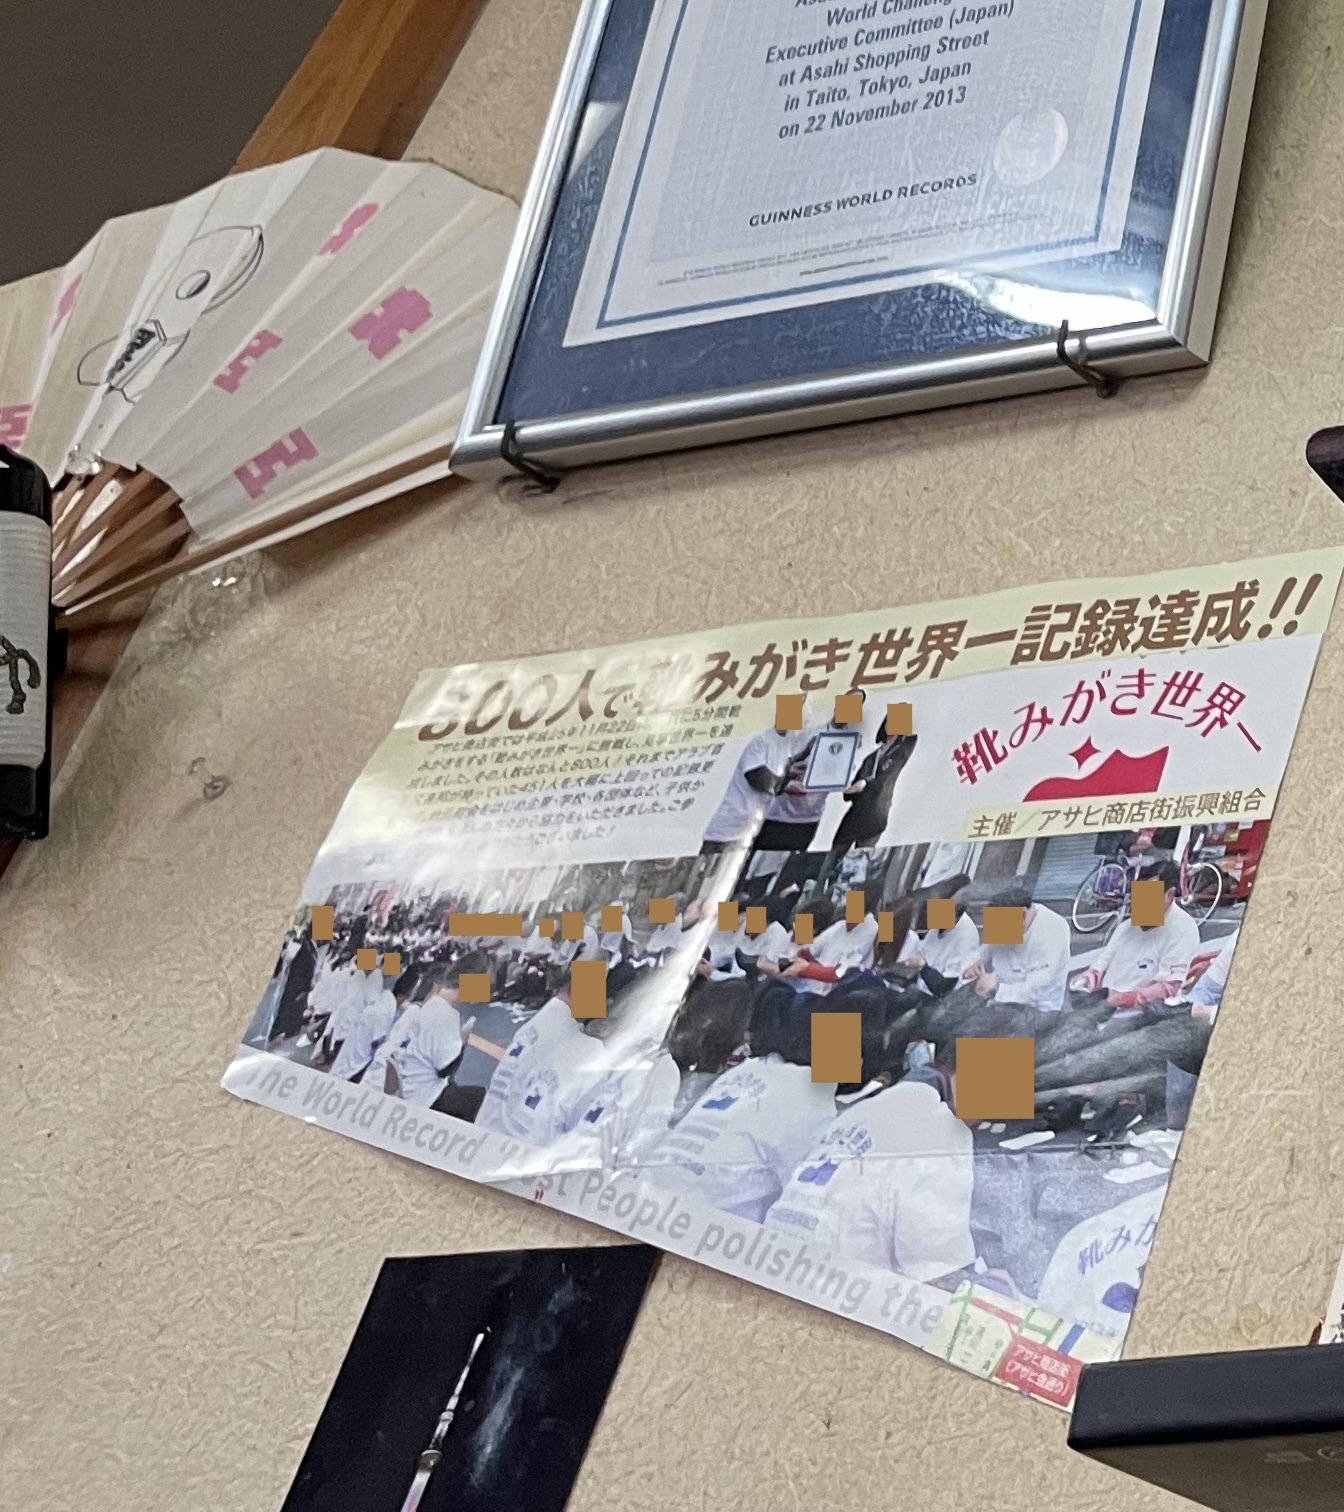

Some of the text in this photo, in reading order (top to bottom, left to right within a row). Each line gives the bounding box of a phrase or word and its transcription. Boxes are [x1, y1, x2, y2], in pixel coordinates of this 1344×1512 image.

[765, 35, 849, 64] Executive
[854, 15, 944, 47] Committee
[827, 0, 878, 28] World
[778, 29, 990, 87] at Asahi Shopping Street
[779, 85, 967, 139] on 22 November 2013
[784, 62, 972, 113] in Taito, Tokyo, Japan
[749, 173, 978, 228] GUINNESS WORLD RECORDS
[300, 1075, 379, 1130] World
[384, 1106, 487, 1165] Record
[578, 1169, 693, 1241] People
[693, 1221, 874, 1315] polishing
[879, 1288, 944, 1336] the
